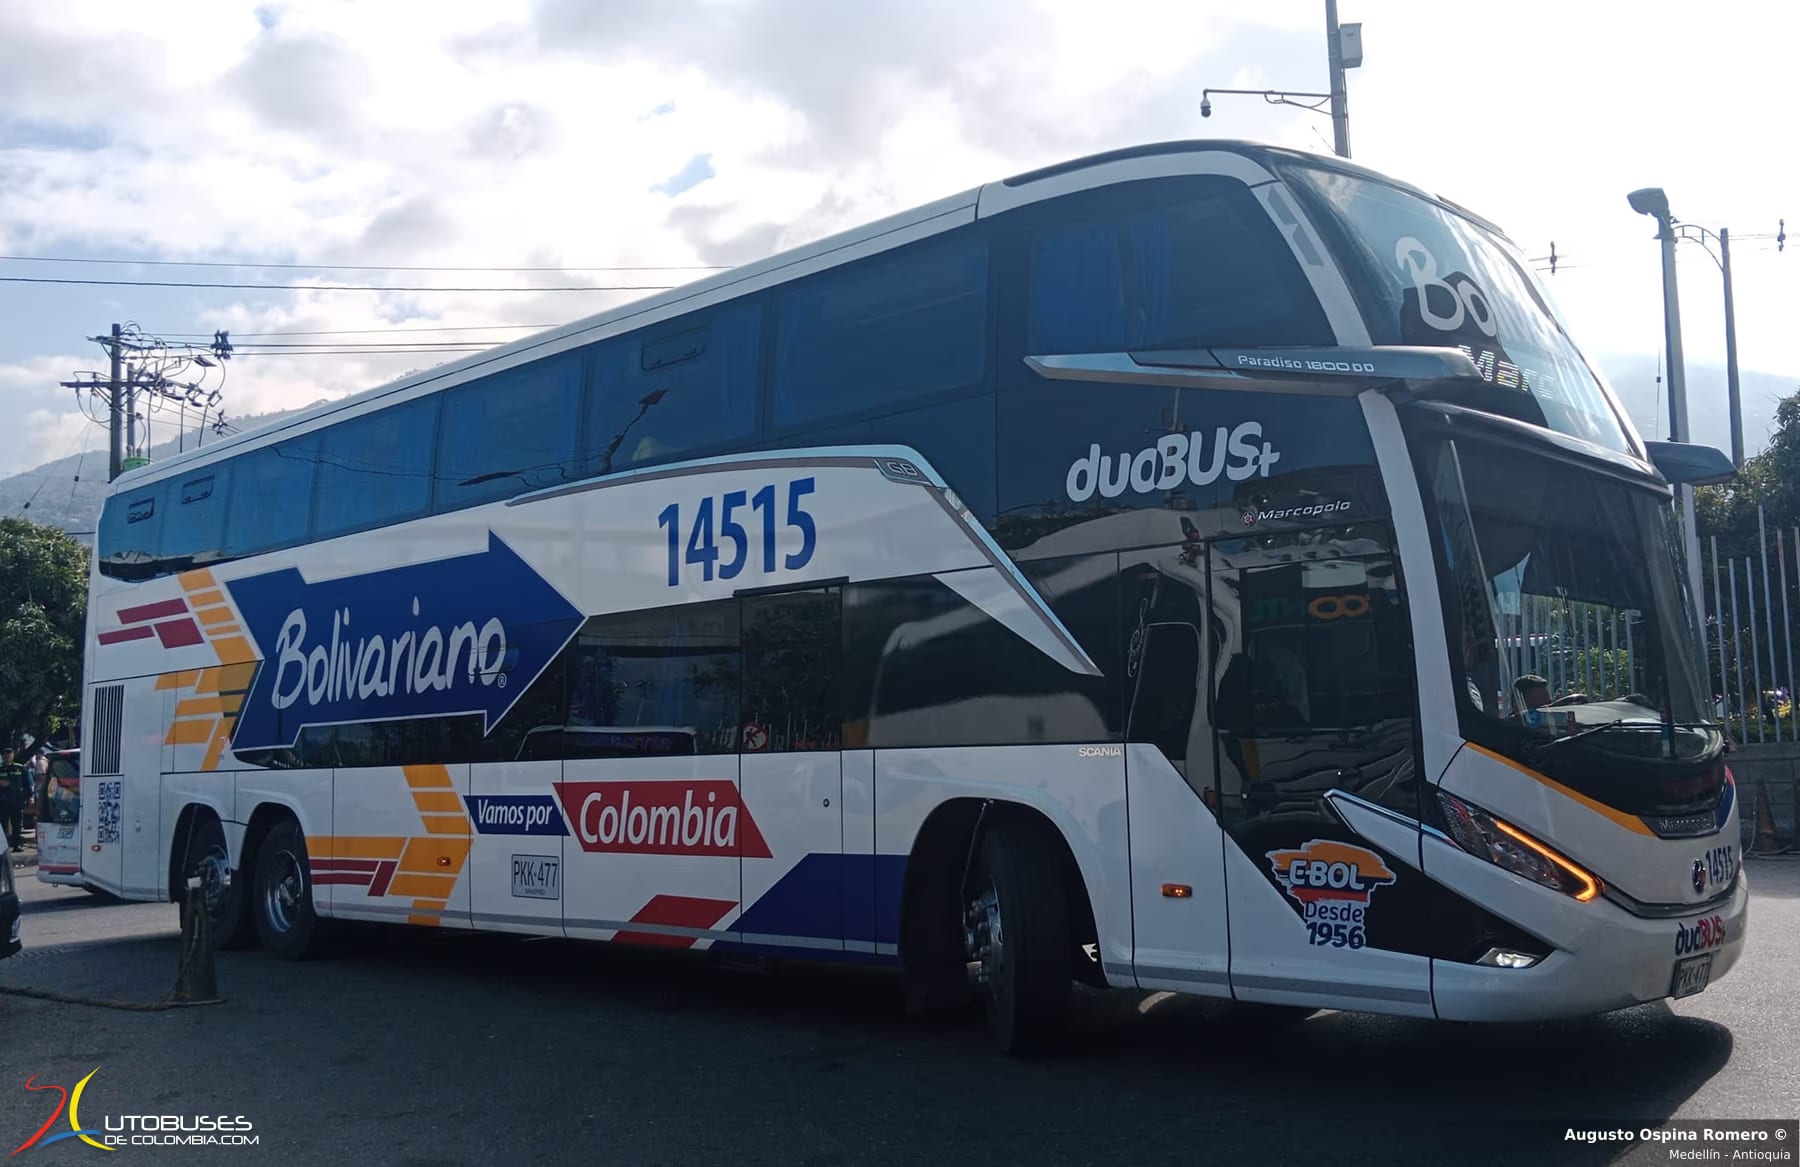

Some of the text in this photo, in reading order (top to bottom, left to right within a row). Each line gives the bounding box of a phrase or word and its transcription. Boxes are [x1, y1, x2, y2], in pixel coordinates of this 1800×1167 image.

[1237, 355, 1303, 369] Paradiso
[1305, 361, 1350, 371] 1800
[1258, 500, 1351, 520] Marcopolo
[658, 477, 817, 587] 14515
[1079, 746, 1122, 757] SCANIA
[478, 790, 738, 847] Vamos por Colombia
[513, 860, 558, 888] PKK-477
[1289, 860, 1365, 890] E-BOL
[1705, 846, 1734, 886] 14515
[1305, 902, 1363, 923] Desde
[1306, 921, 1365, 950] 1956
